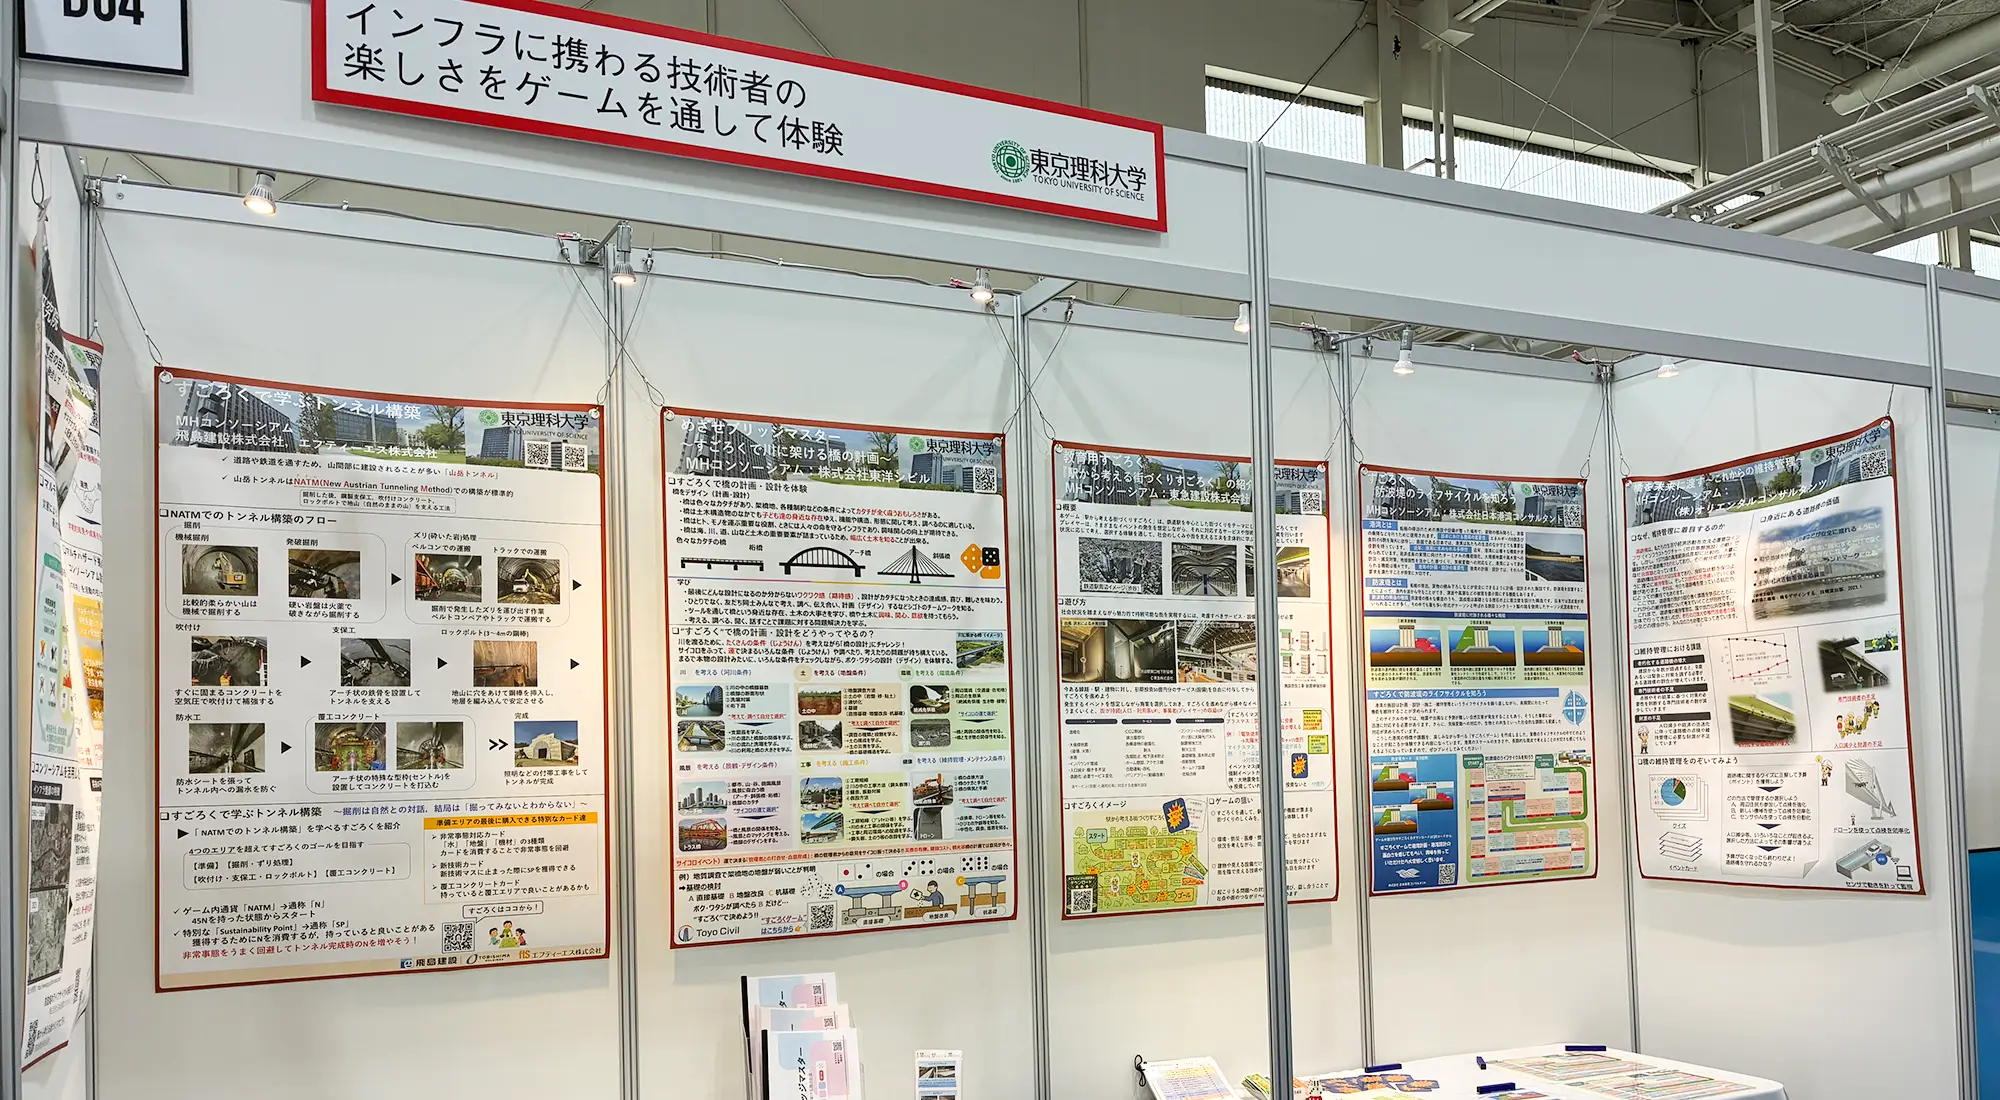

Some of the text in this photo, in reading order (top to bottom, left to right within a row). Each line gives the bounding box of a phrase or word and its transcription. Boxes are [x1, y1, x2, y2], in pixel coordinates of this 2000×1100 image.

[346, 3, 806, 109] インフラに携わる技術者の
[344, 44, 844, 156] 楽しさをゲームを通して体験
[1030, 149, 1146, 191] 東京理科大学
[1033, 175, 1144, 201] TOKYO UNIVERSITY OF SCIENCE
[176, 381, 421, 421] すごろくで学ぶトンネル構築
[176, 415, 293, 433] MHコンソーシアム
[502, 411, 588, 430] 東京理科大学
[682, 418, 840, 443] めざせブリッジマスター
[926, 439, 994, 455] 東京理科大学
[1826, 428, 1880, 459] 東京理科大学
[300, 439, 438, 458] エフティーエス株式会社
[1063, 451, 1144, 468] 教育用すごろく
[344, 481, 513, 498] Austrian Tunneling Method)での構築が標準的
[678, 478, 807, 493] すごろくで橋の計画・設計を体験
[1532, 484, 1578, 497] 東京理科大学
[1376, 487, 1516, 504] 防波堤のライフサイクルを知ろう
[170, 510, 337, 524] NATMでのトンネル構築のフロー
[1369, 521, 1392, 529] 港湾とは
[175, 534, 209, 542] 機械掘削
[286, 538, 318, 546] 発破掘削
[676, 537, 726, 545] 色々なカタチの橋
[412, 544, 471, 552] ベルコンでの運搬
[494, 547, 547, 556] トラックでの運搬
[1372, 579, 1402, 587] 防波堤とは
[182, 599, 257, 607] 比較的柔らかい山は
[289, 601, 352, 610] 硬い岩盤は火薬で
[1064, 598, 1086, 606] 遊び方
[182, 608, 240, 616] 機械で掘削する
[432, 606, 545, 614] 掘削で発生したズリを運び出す作業
[1640, 643, 1701, 655] 維持管理における課題
[175, 689, 282, 697] すぐに固まるコンクリートを
[330, 689, 421, 697] アーチ状の鉄骨を設置して
[1373, 689, 1487, 698] すごろくで防波堤のライフサイクルを知ろう
[175, 697, 274, 706] 空気圧で吹付けて補強する
[330, 697, 391, 705] トンネルを支える
[452, 697, 544, 705] 地層を編み込んで安定させる
[176, 713, 201, 721] 防水工
[318, 713, 380, 721] 覆工コンクリート
[1643, 757, 1738, 765] 橋の維持管理をのぞいてみよう
[504, 769, 588, 778] 照明などの付帯工事をして
[176, 777, 251, 785] 防水シートを張って
[504, 778, 554, 786] トンネルが完成
[176, 785, 276, 794] トンネル内への漏水を防ぐ
[332, 781, 439, 791] 設置してコンクリートを打込む
[1071, 801, 1126, 809] すごろくイメージ
[172, 807, 322, 820] すごろくで学ぶトンネル構築
[436, 815, 586, 826] 準備エリアの最後に購入できる特別なカード達
[440, 831, 505, 839] 非常事態対応カード
[189, 841, 364, 854] 4つのエリアを超えてすごろくのゴールを目指す
[440, 845, 569, 857] カードを消費することで非常事態を回避
[440, 861, 483, 869] 新技術カード
[440, 879, 520, 890] 覆工コンクリートカード
[687, 883, 721, 891] 基礎の検討
[440, 884, 590, 899] 持っていると覆工エリアで良いことがあるかも
[696, 893, 724, 901] 直接基礎
[192, 911, 316, 925] 45Nを持った状態からスタート
[697, 927, 739, 938] Toyo Civil
[761, 926, 793, 935] はこちらから
[416, 947, 602, 968] 飛島建設 エフティーエス株式会社
